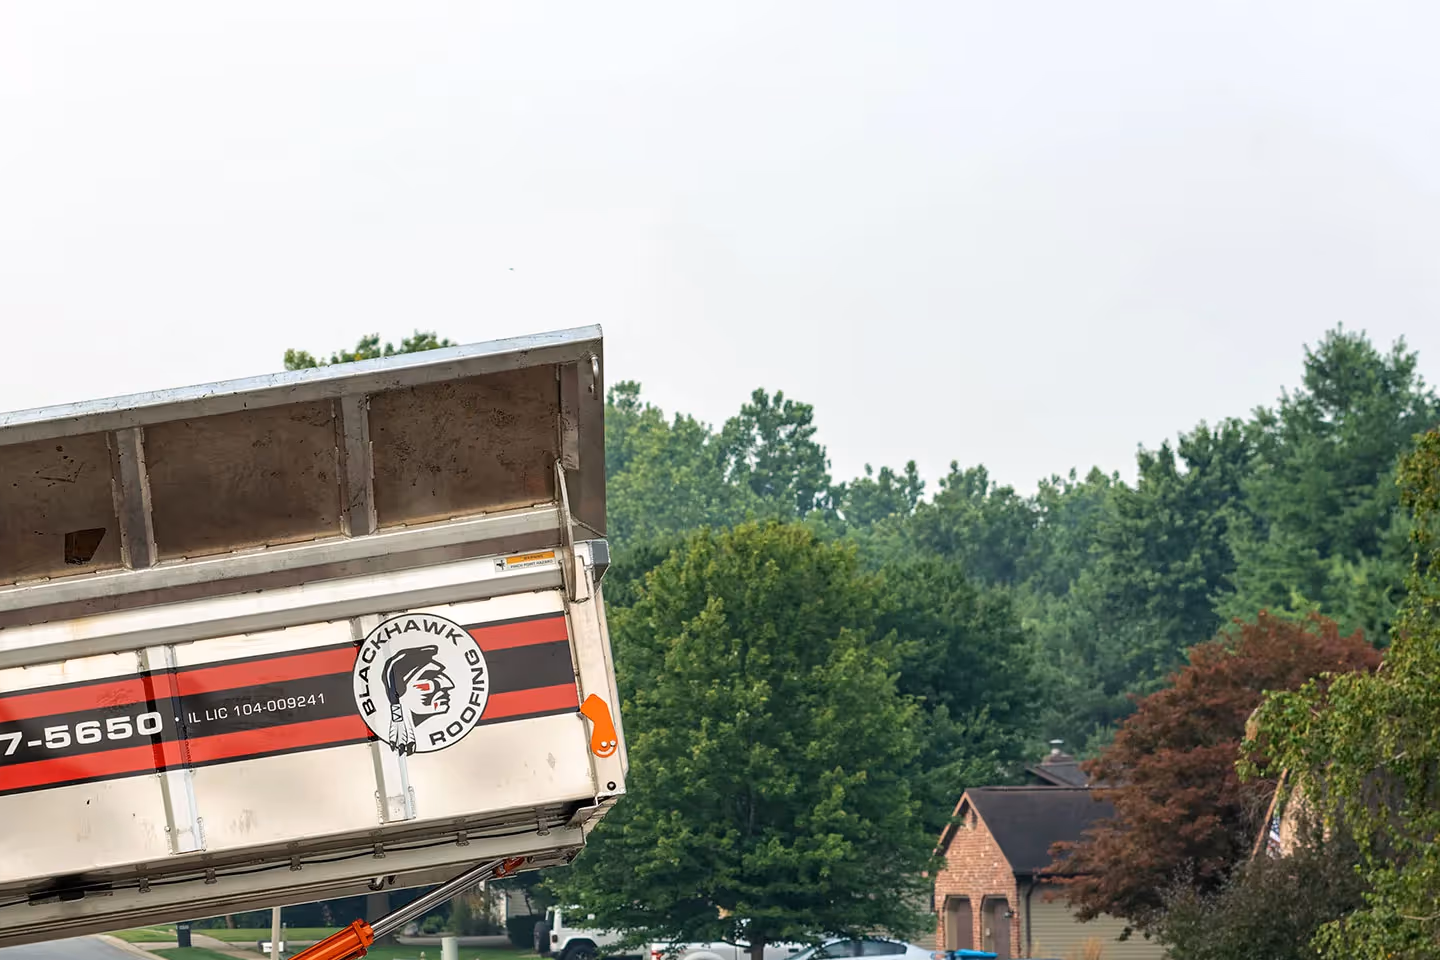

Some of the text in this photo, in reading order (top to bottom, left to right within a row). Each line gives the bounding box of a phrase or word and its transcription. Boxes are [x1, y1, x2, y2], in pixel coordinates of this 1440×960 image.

[188, 712, 201, 724] IL
[206, 707, 228, 721] LIC
[233, 693, 326, 717] 104-009241
[359, 619, 464, 716] BLACKHAWK
[429, 649, 485, 746] ROOFING
